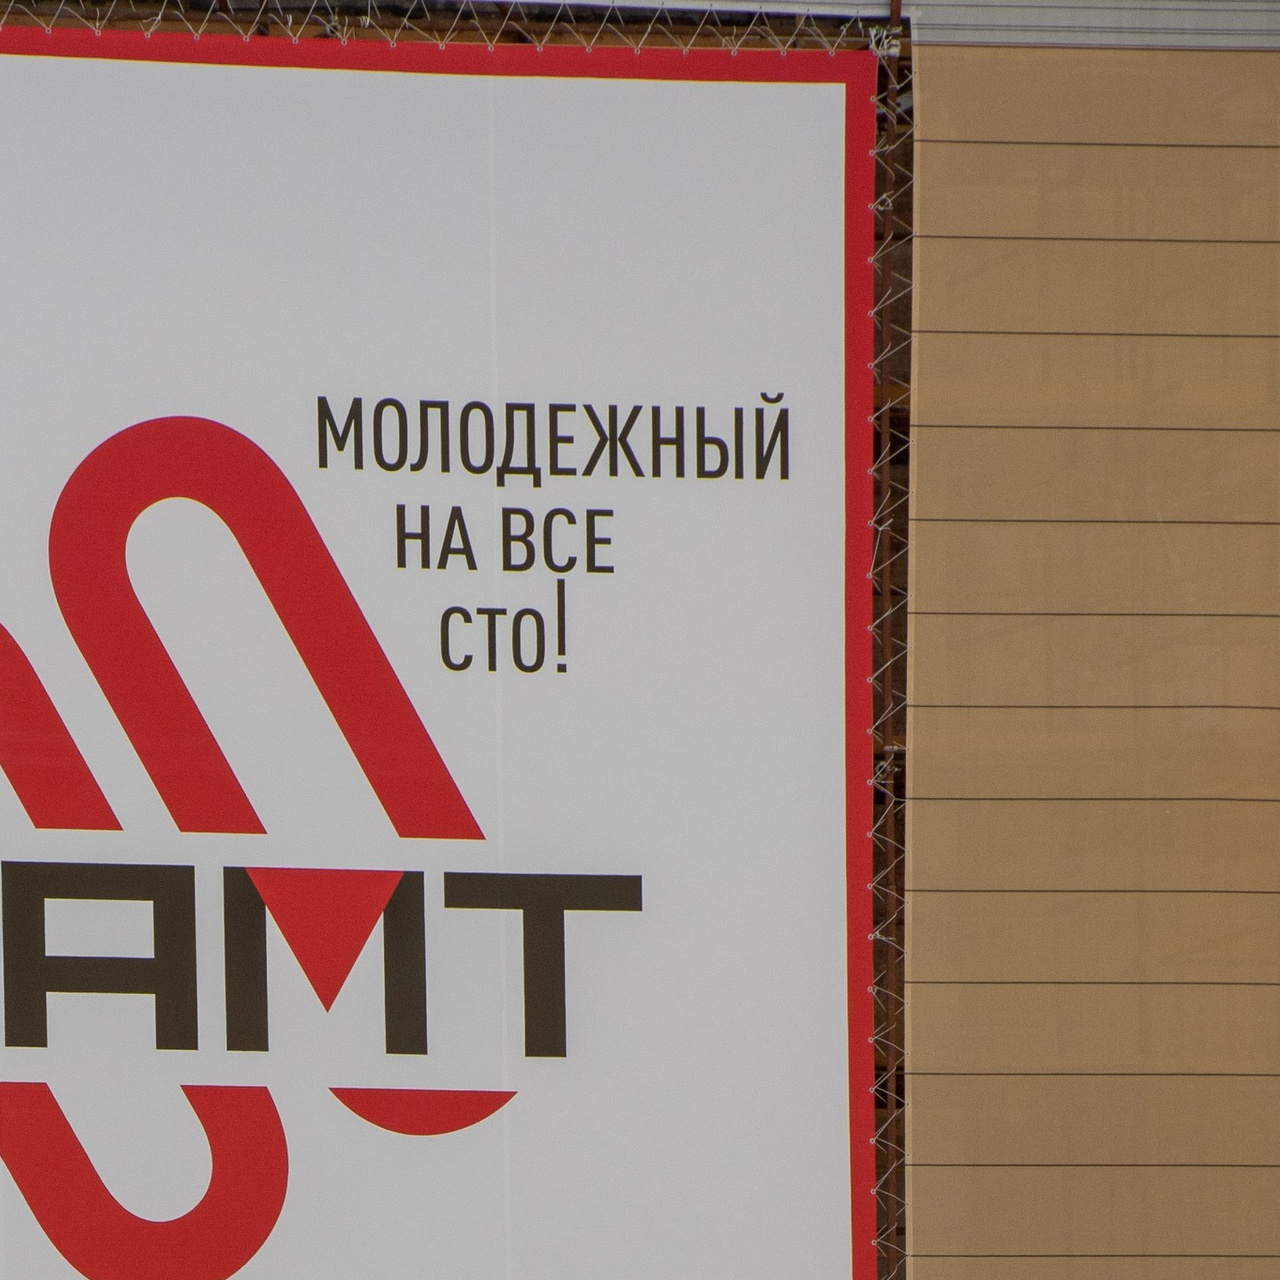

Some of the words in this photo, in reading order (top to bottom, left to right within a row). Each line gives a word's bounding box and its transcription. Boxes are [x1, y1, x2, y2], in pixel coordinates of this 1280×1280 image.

[317, 392, 790, 489] МОЛОДЕЖНЫЙ
[395, 503, 478, 571] НА
[500, 506, 615, 574] ВСЕ
[439, 578, 568, 674] СТО!
